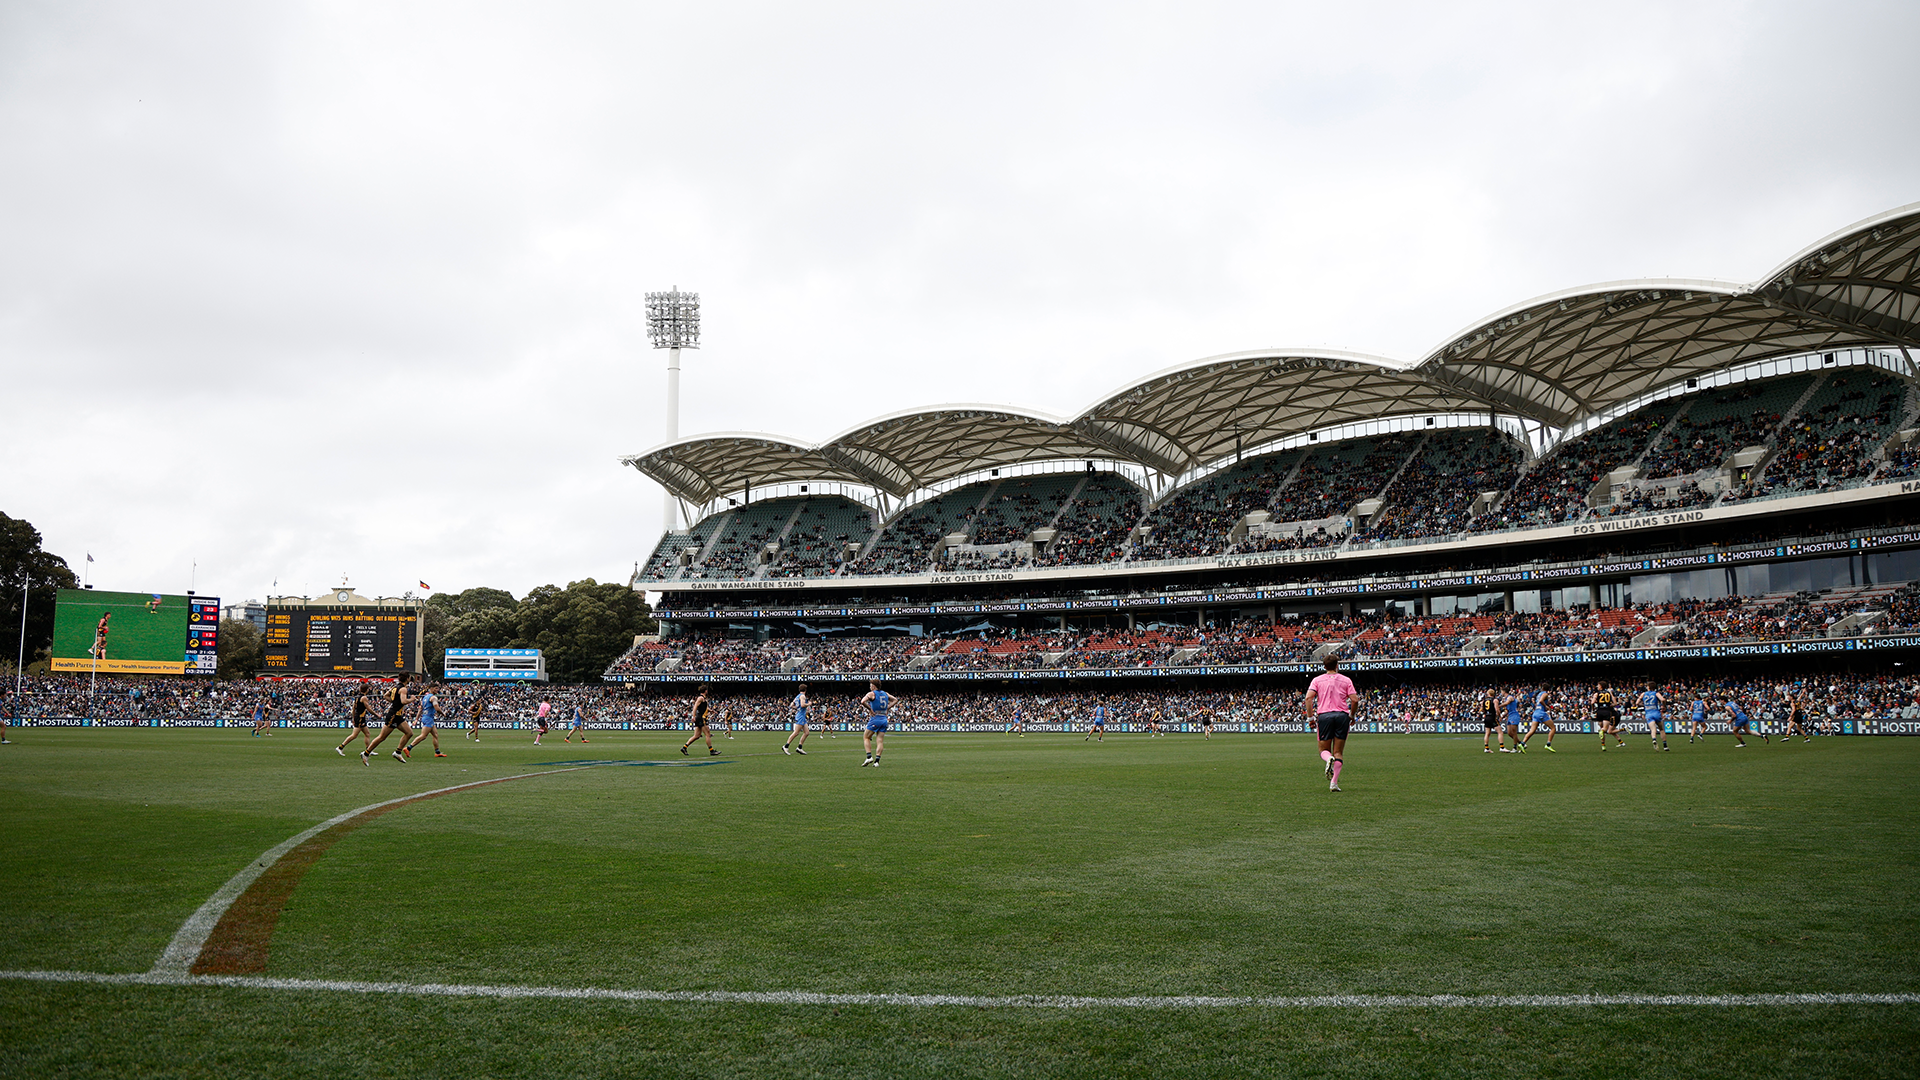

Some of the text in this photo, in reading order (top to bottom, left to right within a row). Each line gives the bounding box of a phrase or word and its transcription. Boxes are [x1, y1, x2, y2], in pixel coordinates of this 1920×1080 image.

[1573, 511, 1704, 534] FOS WILLIAMS STAND
[1218, 551, 1337, 568] MAX BASHEER STAND
[1177, 595, 1207, 603] HOSTPLUS
[1225, 592, 1256, 600] HOSTPLUS
[1274, 589, 1306, 597] HOSTPLUS
[1325, 586, 1357, 594] HOSTPLUS
[1377, 582, 1410, 591] HOSTPLUS
[1430, 577, 1464, 587] HOSTPLUS
[1486, 573, 1521, 582] HOSTPLUS
[1543, 567, 1580, 578] HOSTPLUS
[1603, 562, 1641, 572] HOSTPLUS
[1666, 555, 1706, 567] HOSTPLUS
[1732, 548, 1774, 560] HOSTPLUS
[1802, 540, 1848, 553] HOSTPLUS
[930, 573, 1014, 584] JACK OATEY STAND
[720, 581, 775, 589] WANGANEEN
[1267, 665, 1298, 673] HOSTPLUS
[1368, 661, 1402, 670] HOSTPLUS
[1423, 659, 1457, 668] HOSTPLUS
[1478, 657, 1514, 666] HOSTPLUS
[1536, 654, 1573, 663] HOSTPLUS
[1596, 652, 1635, 661] HOSTPLUS
[1659, 648, 1700, 658] HOSTPLUS
[1726, 645, 1770, 655] HOSTPLUS
[1797, 641, 1843, 652] HOSTPLUS
[879, 696, 887, 709] 5
[1598, 692, 1611, 703] 20
[1643, 695, 1655, 705] 22
[1484, 700, 1490, 710] 9
